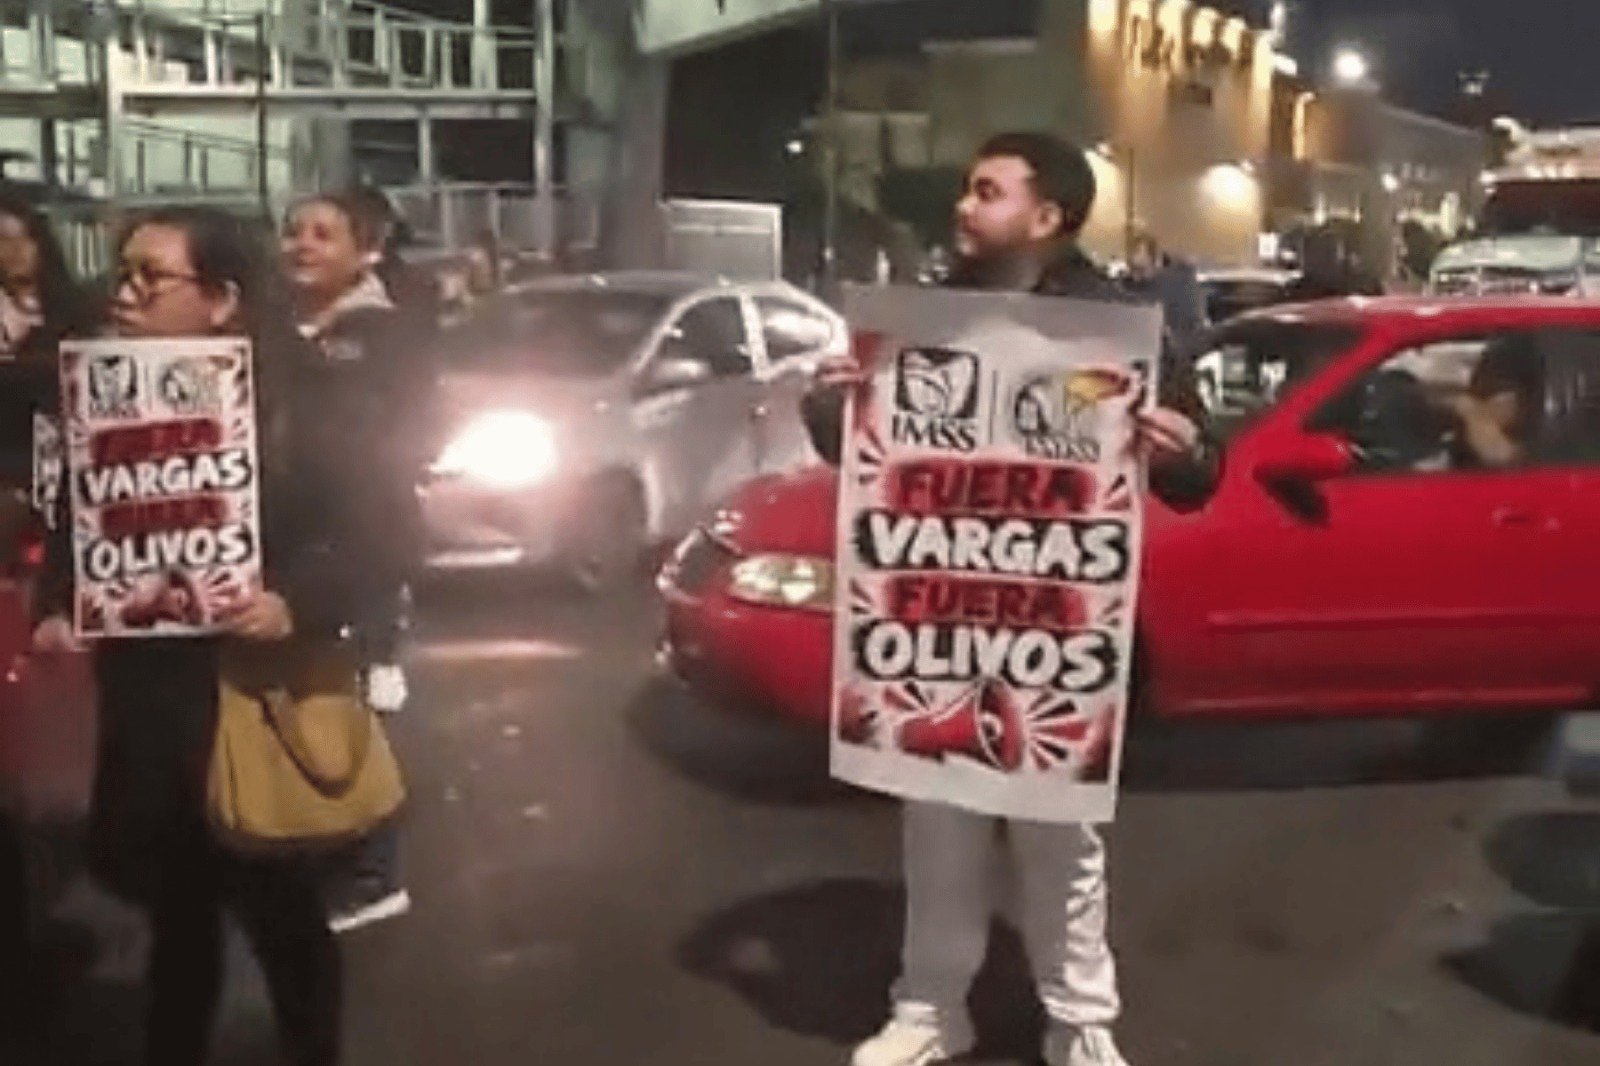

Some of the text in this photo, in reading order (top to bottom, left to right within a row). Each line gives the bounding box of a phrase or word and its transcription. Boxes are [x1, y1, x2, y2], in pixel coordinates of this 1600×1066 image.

[892, 413, 977, 451] IMSS
[86, 452, 250, 502] VARGAS
[898, 461, 1082, 512] FUERA
[90, 524, 249, 578] OLIVOS
[867, 513, 1122, 580] VARGAS
[863, 621, 1106, 690] OLIVOS
